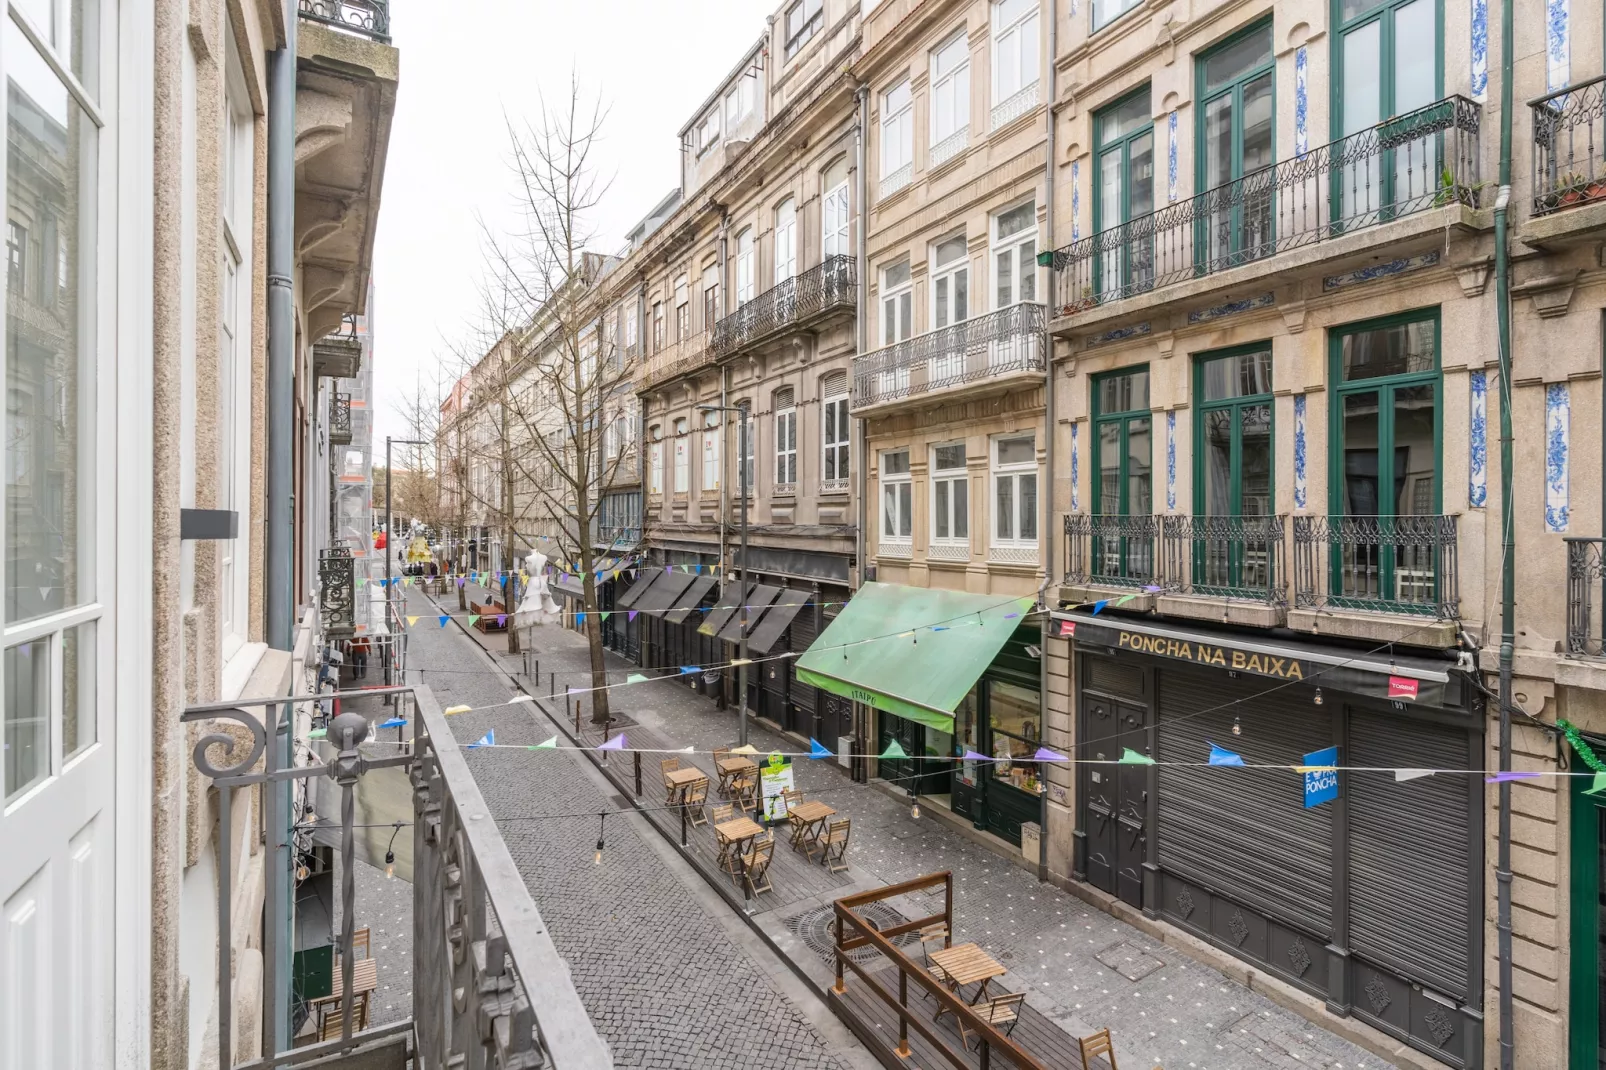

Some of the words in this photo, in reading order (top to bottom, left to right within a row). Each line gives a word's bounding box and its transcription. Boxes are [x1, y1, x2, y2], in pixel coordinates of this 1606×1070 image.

[1118, 631, 1193, 660] PONCHA
[1197, 645, 1227, 667] NA
[1232, 651, 1304, 680] BAIXA
[1305, 774, 1338, 795] PONCHA
